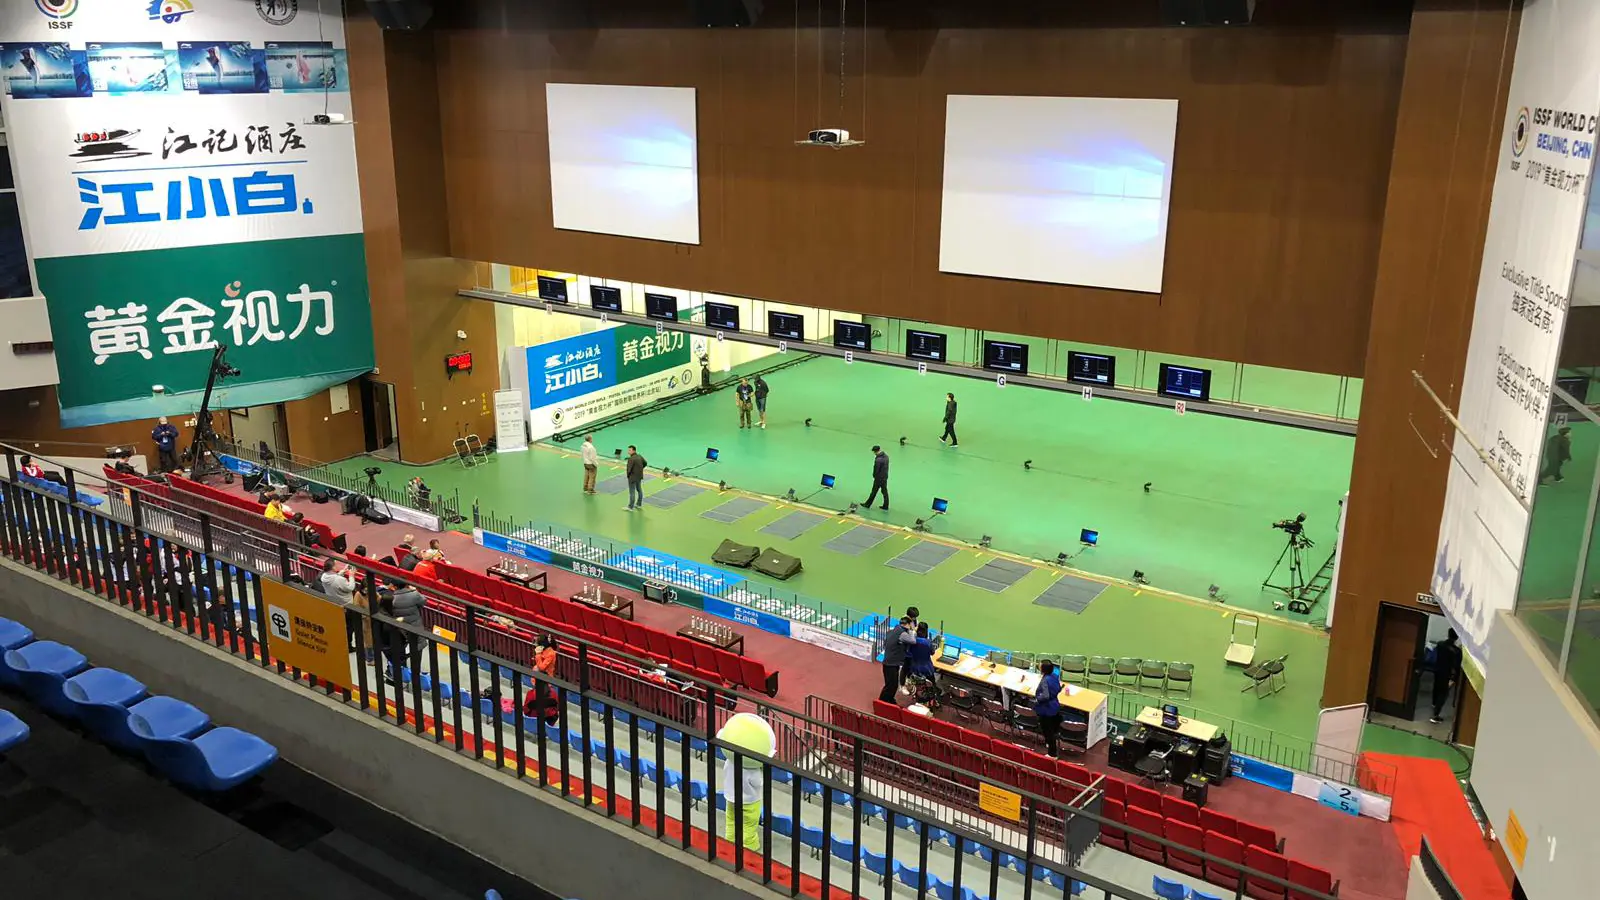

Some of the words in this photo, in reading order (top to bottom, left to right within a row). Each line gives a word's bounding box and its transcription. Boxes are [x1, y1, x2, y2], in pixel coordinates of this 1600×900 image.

[48, 21, 73, 30] ISSF
[1533, 108, 1552, 126] ISSF
[1553, 110, 1586, 132] WORLD
[162, 122, 306, 160] 江记酒庄
[1502, 262, 1530, 292] Exclusive
[1530, 276, 1544, 300] Title
[602, 314, 607, 322] A
[84, 283, 337, 366] 黄金视力
[657, 323, 662, 332] B
[718, 332, 723, 340] C
[780, 343, 786, 352] D
[846, 353, 851, 362] E
[919, 364, 925, 374] F
[998, 376, 1005, 386] G
[1084, 388, 1091, 399] H
[1176, 402, 1184, 414] R2
[1339, 788, 1351, 800] 2
[1340, 801, 1349, 811] 5
